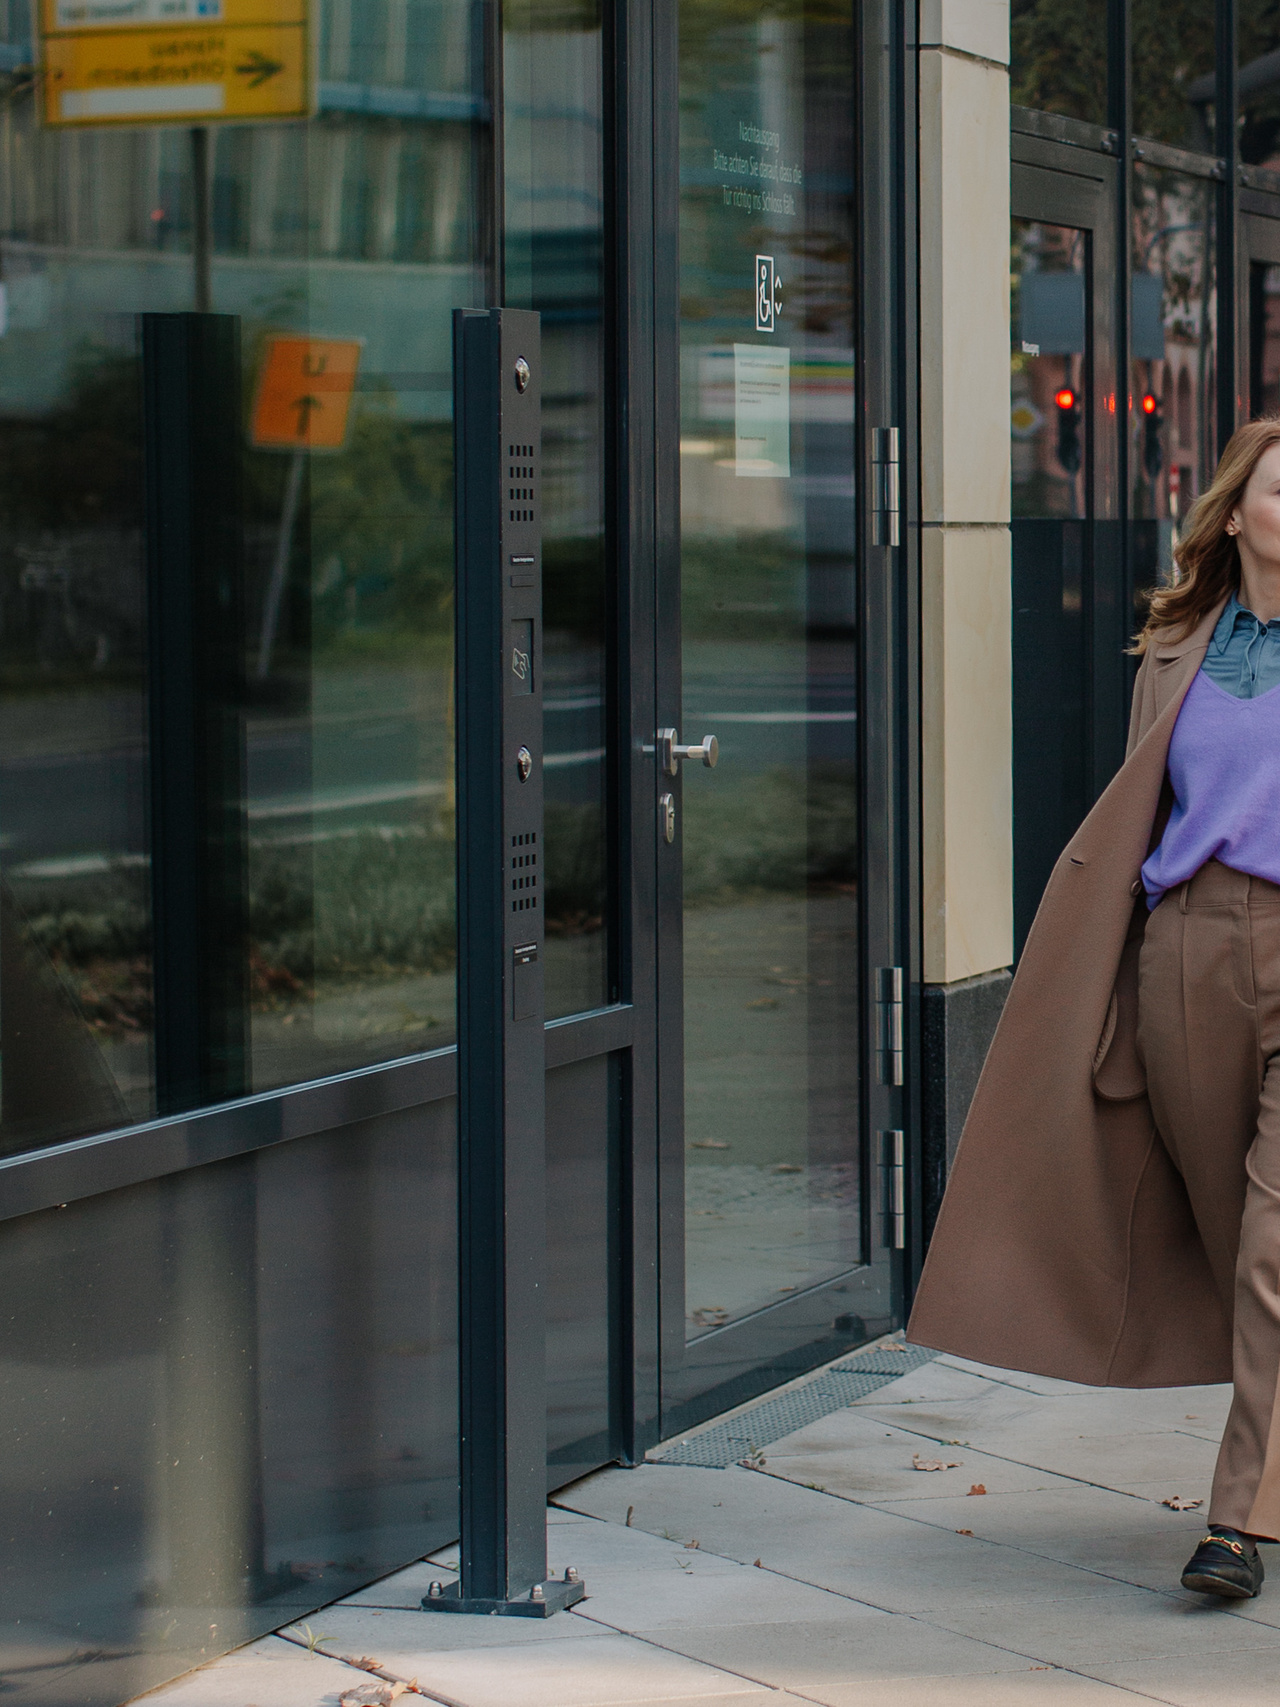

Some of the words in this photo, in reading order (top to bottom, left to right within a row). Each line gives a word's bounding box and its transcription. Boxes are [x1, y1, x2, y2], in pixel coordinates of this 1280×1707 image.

[739, 121, 780, 153] Nachtausgang
[714, 149, 728, 171] Bitte
[729, 152, 748, 174] achten
[749, 155, 758, 176] Sie
[780, 160, 792, 182] dass
[793, 163, 802, 184] die
[722, 184, 732, 205] Tür
[733, 186, 751, 214] richtig
[752, 189, 761, 210] ins
[762, 191, 783, 213] Schloss
